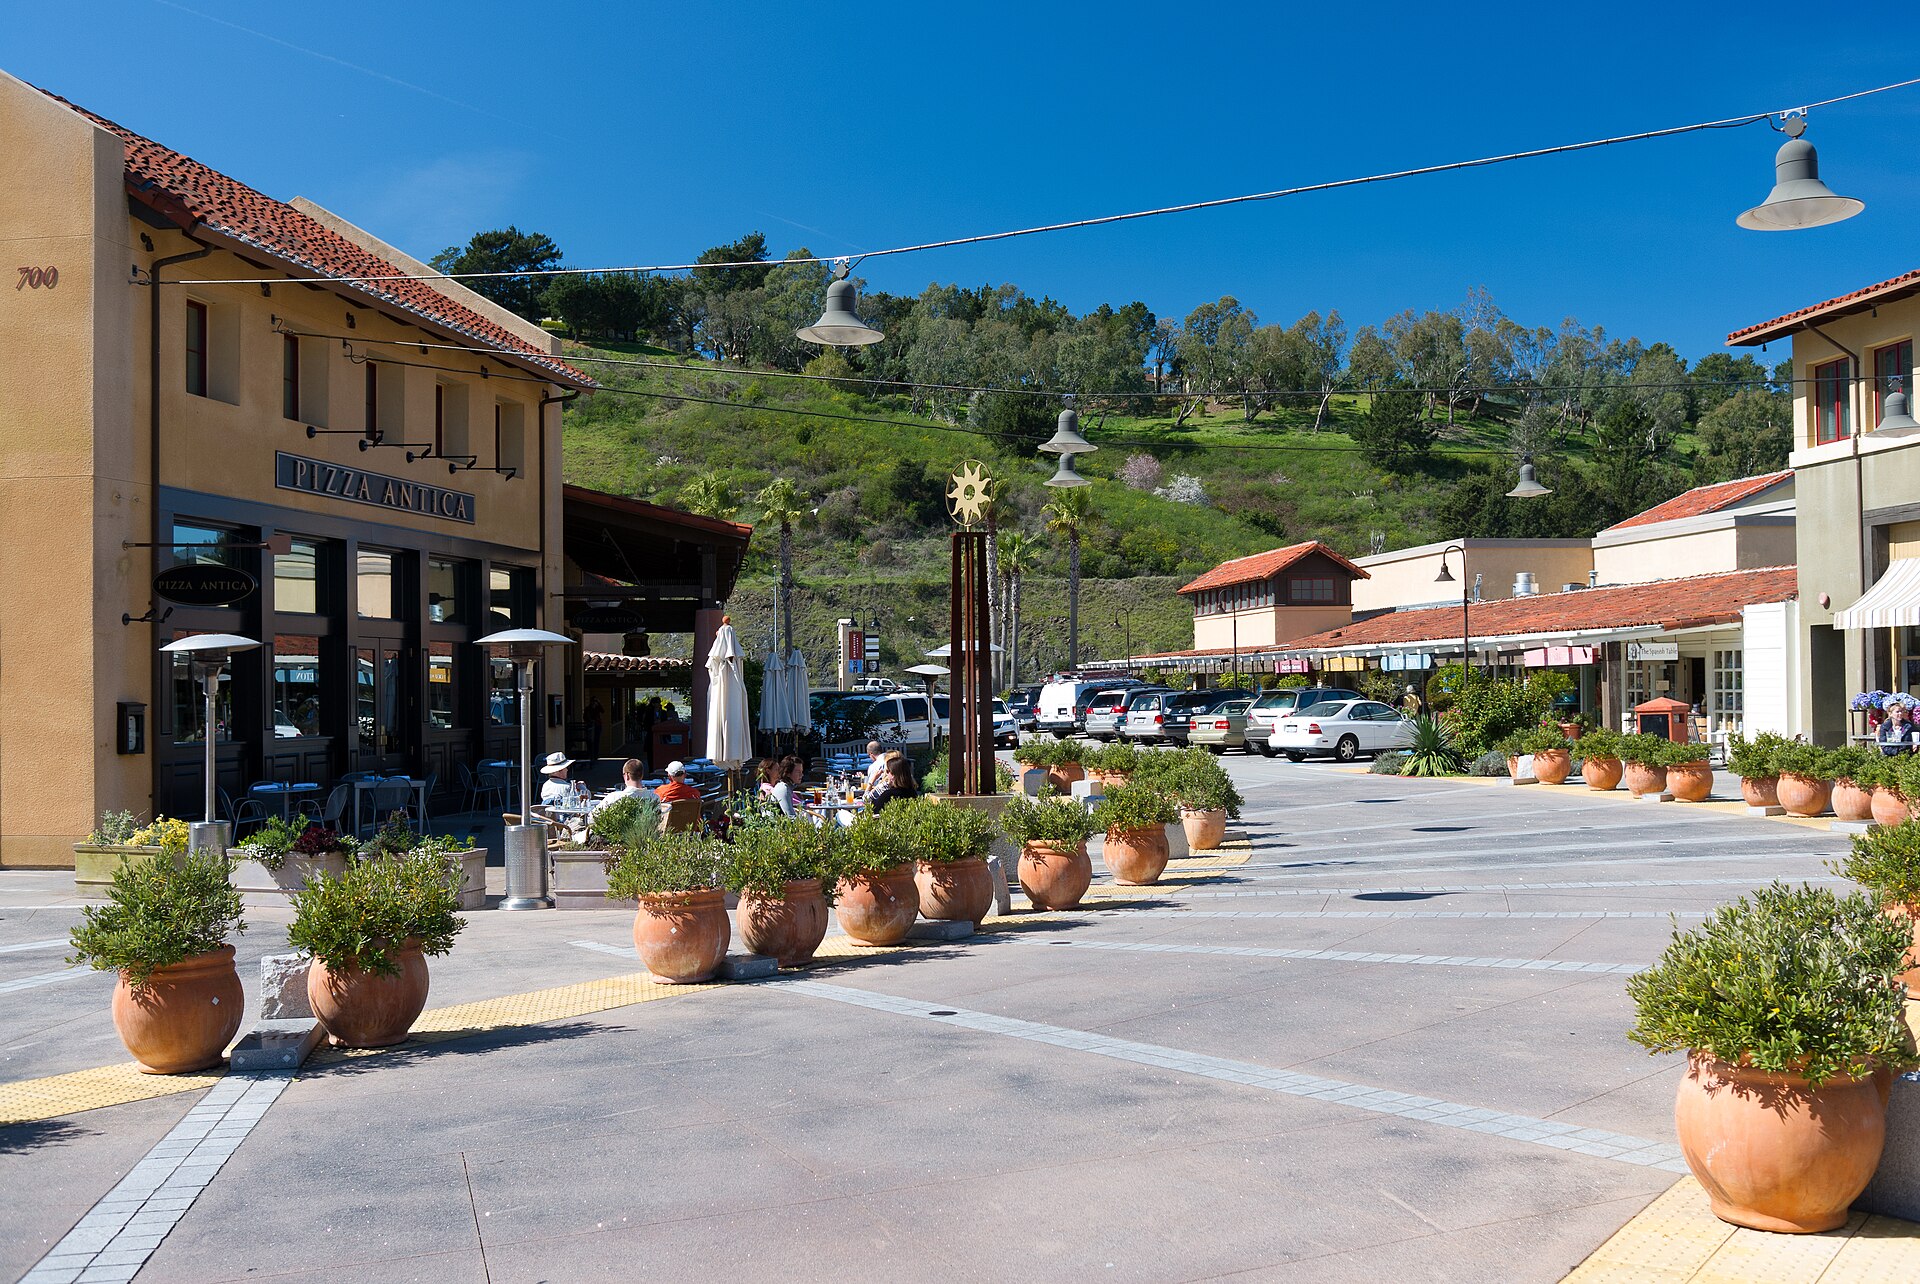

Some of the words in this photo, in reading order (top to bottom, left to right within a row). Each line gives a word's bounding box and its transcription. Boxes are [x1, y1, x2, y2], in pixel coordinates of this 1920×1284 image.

[16, 265, 58, 291] 700
[294, 459, 371, 500] PIZZA
[384, 480, 467, 519] ANTICA
[158, 581, 193, 590] PIZZA
[200, 581, 247, 590] ANTICA
[576, 616, 601, 624] PIZZA
[604, 616, 639, 624] ANTICA
[1641, 647, 1649, 655] The
[1649, 647, 1665, 656] Spanish
[1666, 647, 1678, 655] Table
[1393, 658, 1418, 668] PENETON
